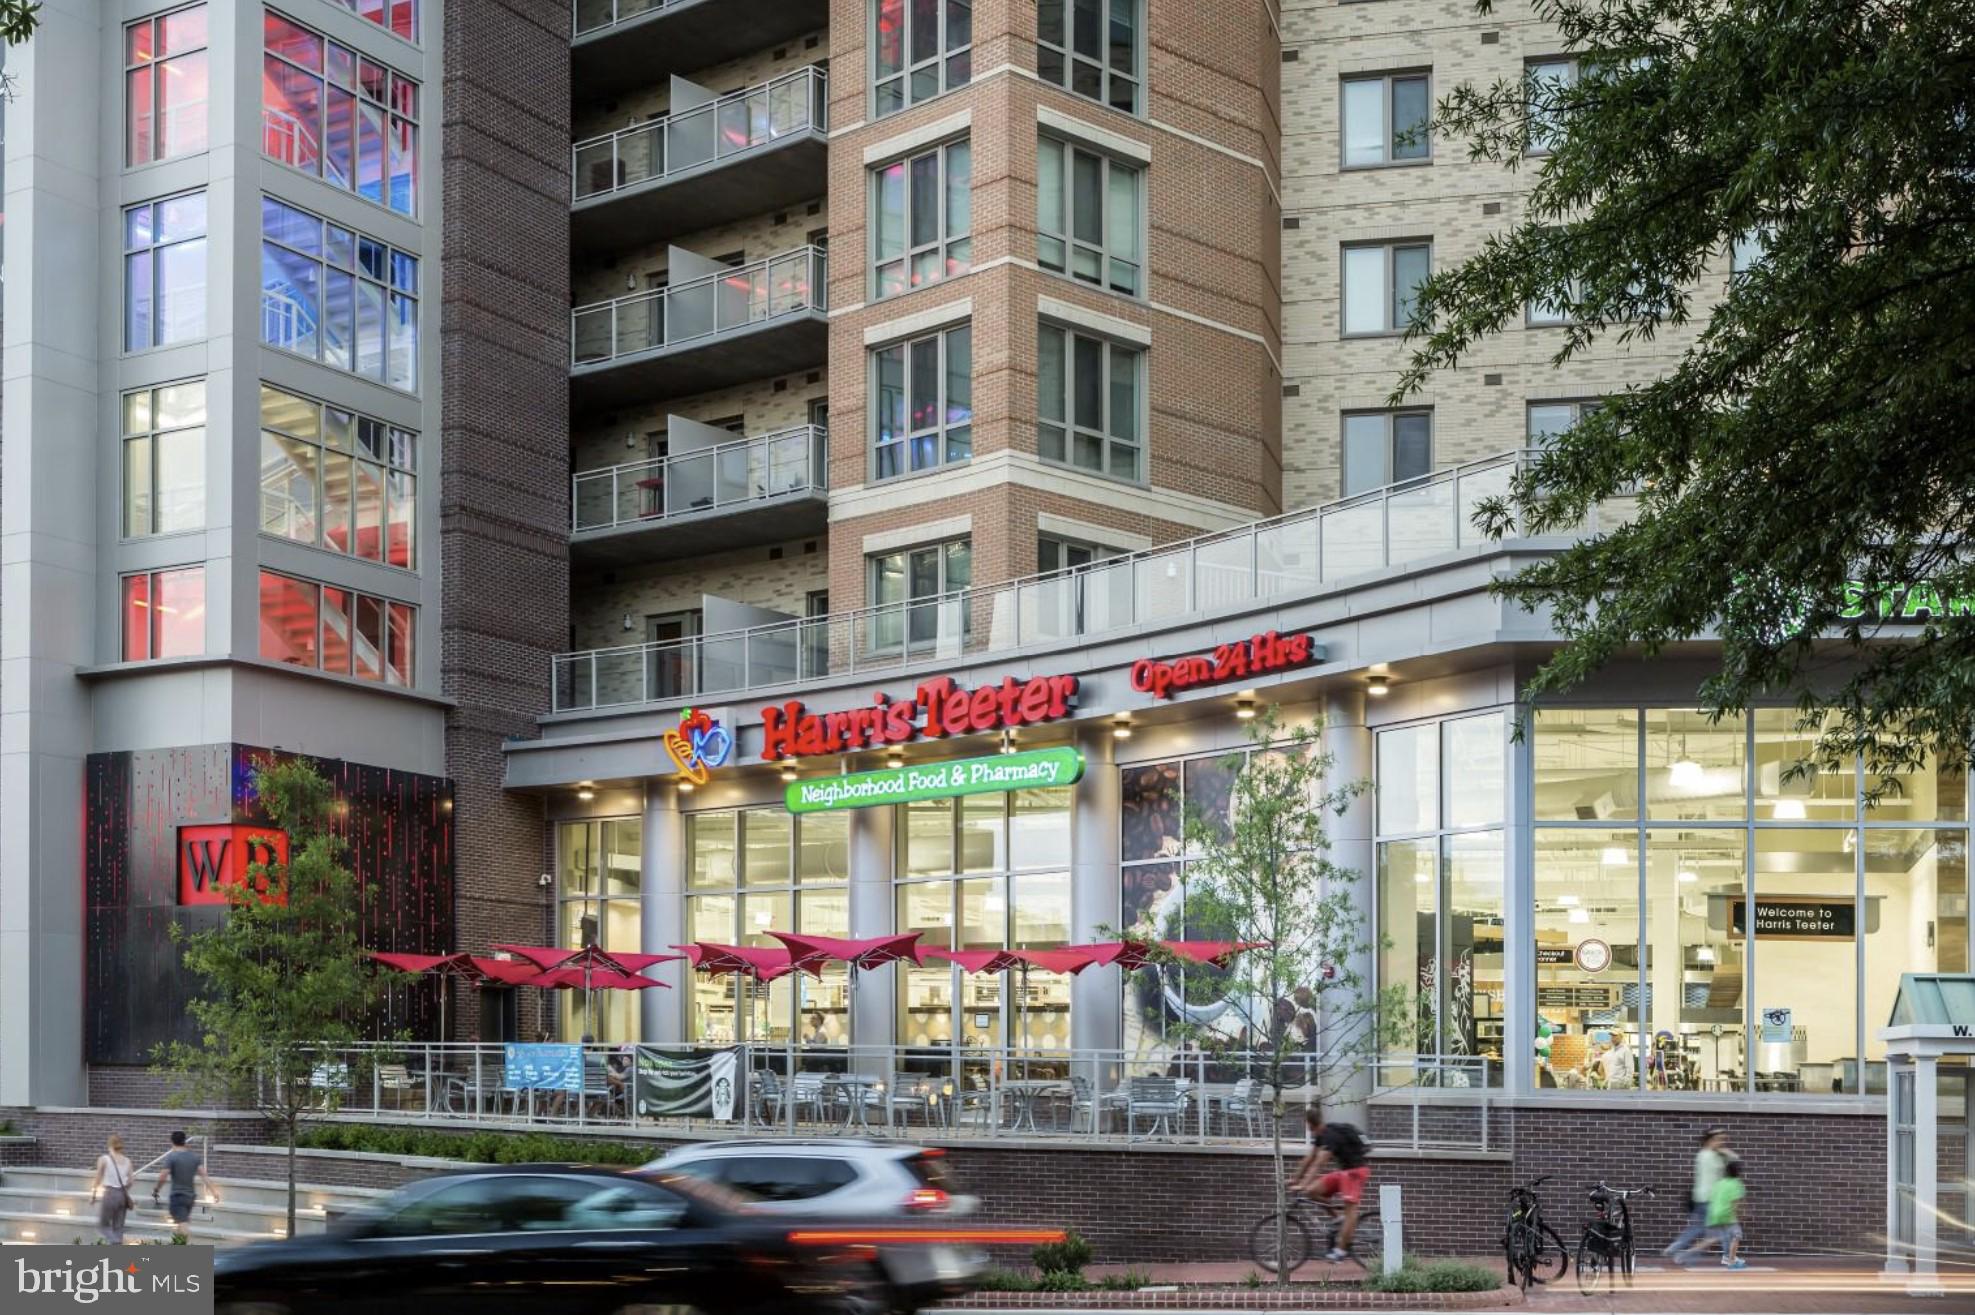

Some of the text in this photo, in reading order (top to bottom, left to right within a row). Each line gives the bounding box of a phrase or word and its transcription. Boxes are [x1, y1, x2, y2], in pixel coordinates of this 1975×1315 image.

[1131, 630, 1310, 699] Open 24 Hrs
[761, 675, 1077, 761] Harris Teeter
[800, 759, 1061, 806] Neighborhood Food & Pharmacy
[1756, 919, 1835, 930] Harris Teeter
[1757, 907, 1832, 918] Welcome to
[1953, 1025, 1973, 1037] W.
